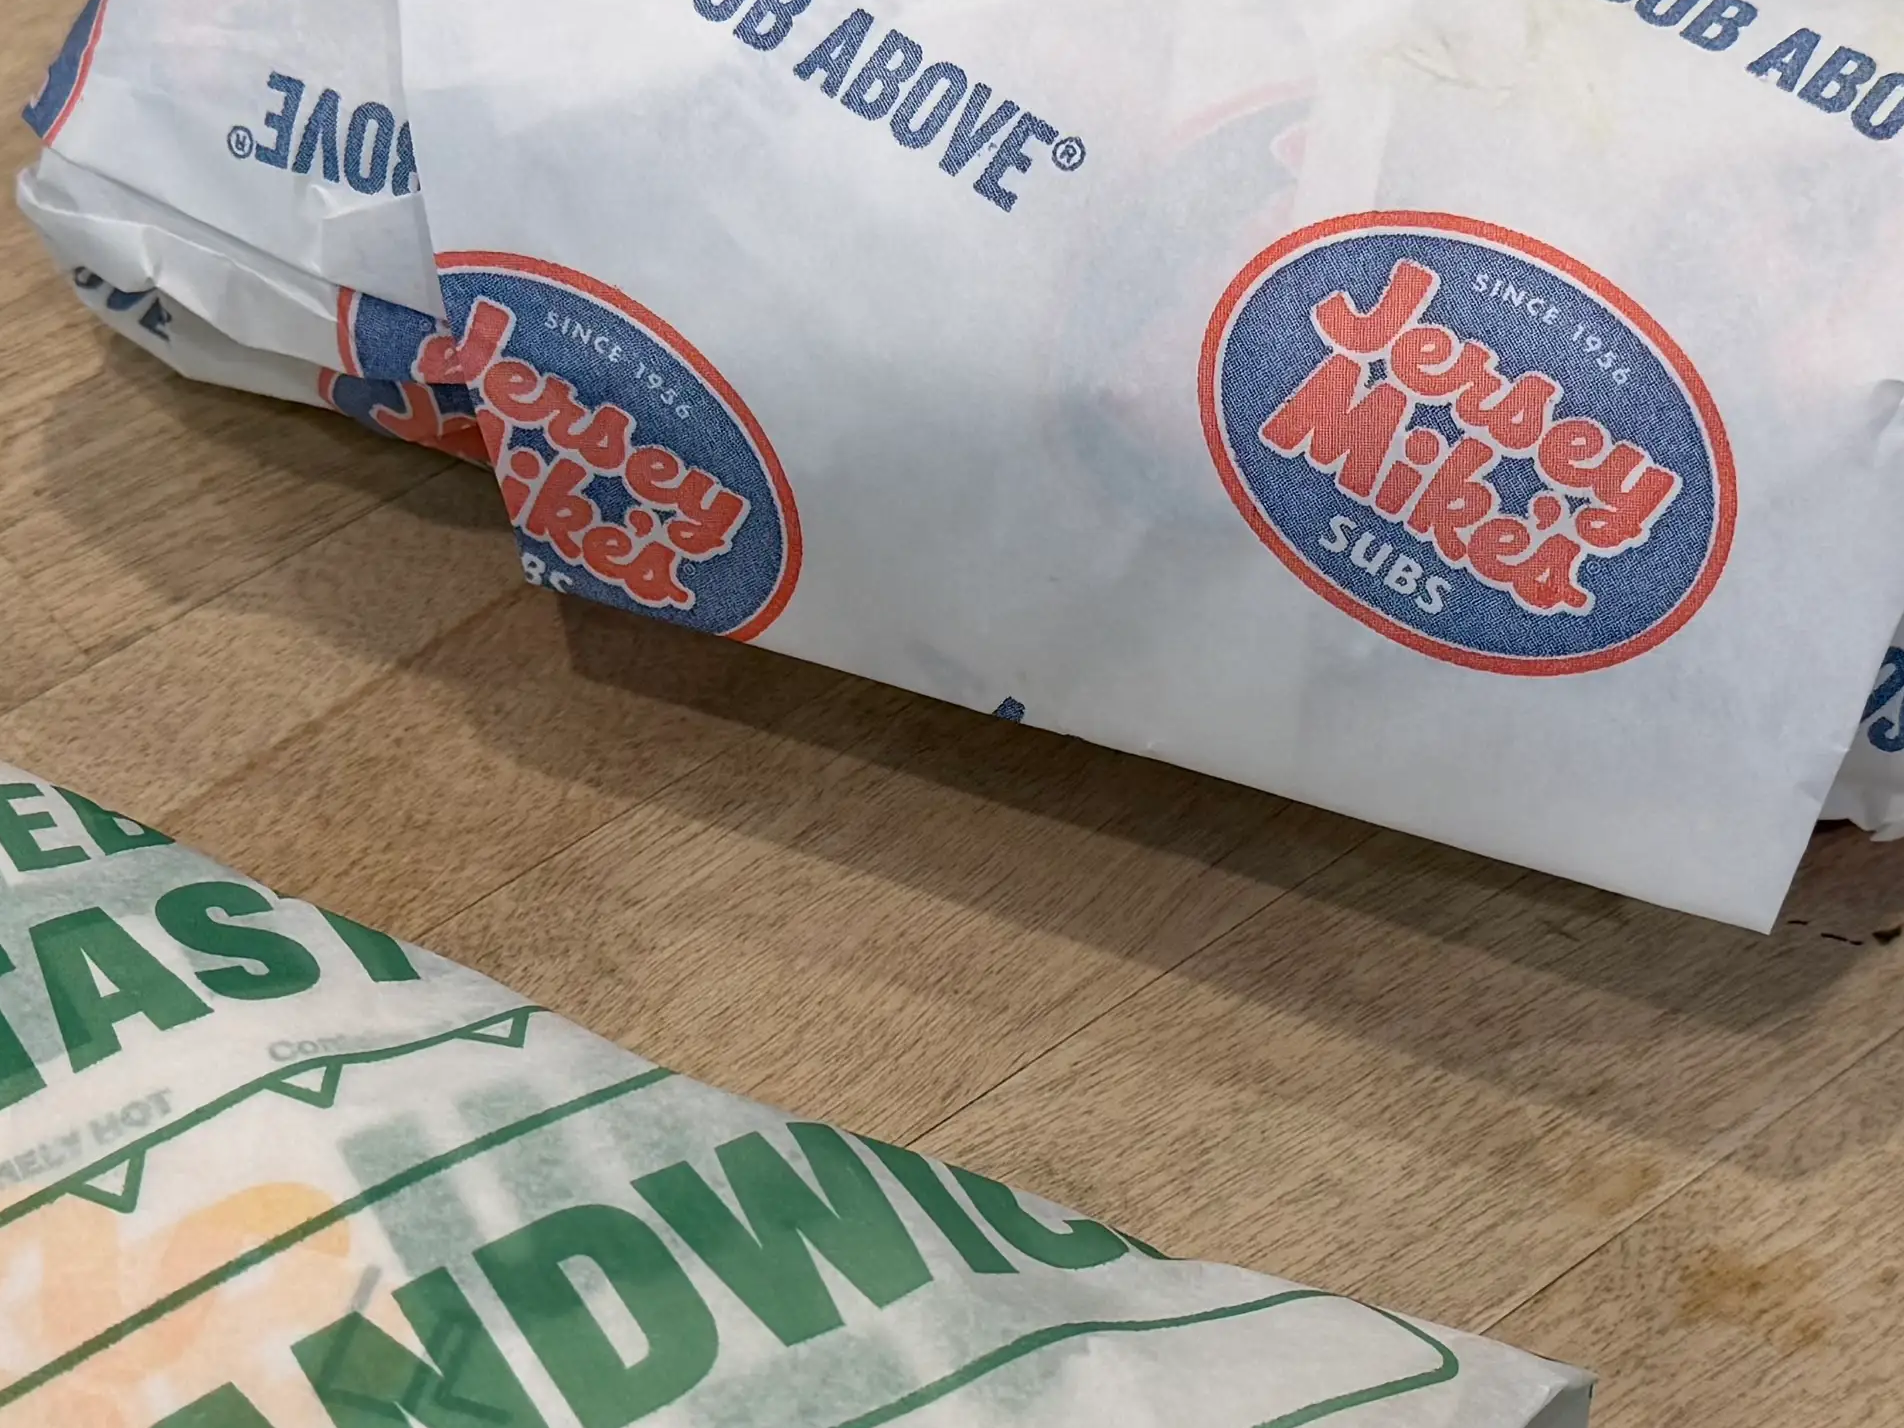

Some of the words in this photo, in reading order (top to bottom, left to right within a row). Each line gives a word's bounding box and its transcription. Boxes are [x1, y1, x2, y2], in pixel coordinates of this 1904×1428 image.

[544, 309, 624, 363] SINCE
[634, 361, 693, 420] 1956
[1472, 272, 1561, 326] SINCE
[1571, 322, 1632, 386] 1956
[1310, 256, 1684, 558] Jersey
[1258, 351, 1596, 618] Mike's
[1318, 513, 1453, 617] SUBS
